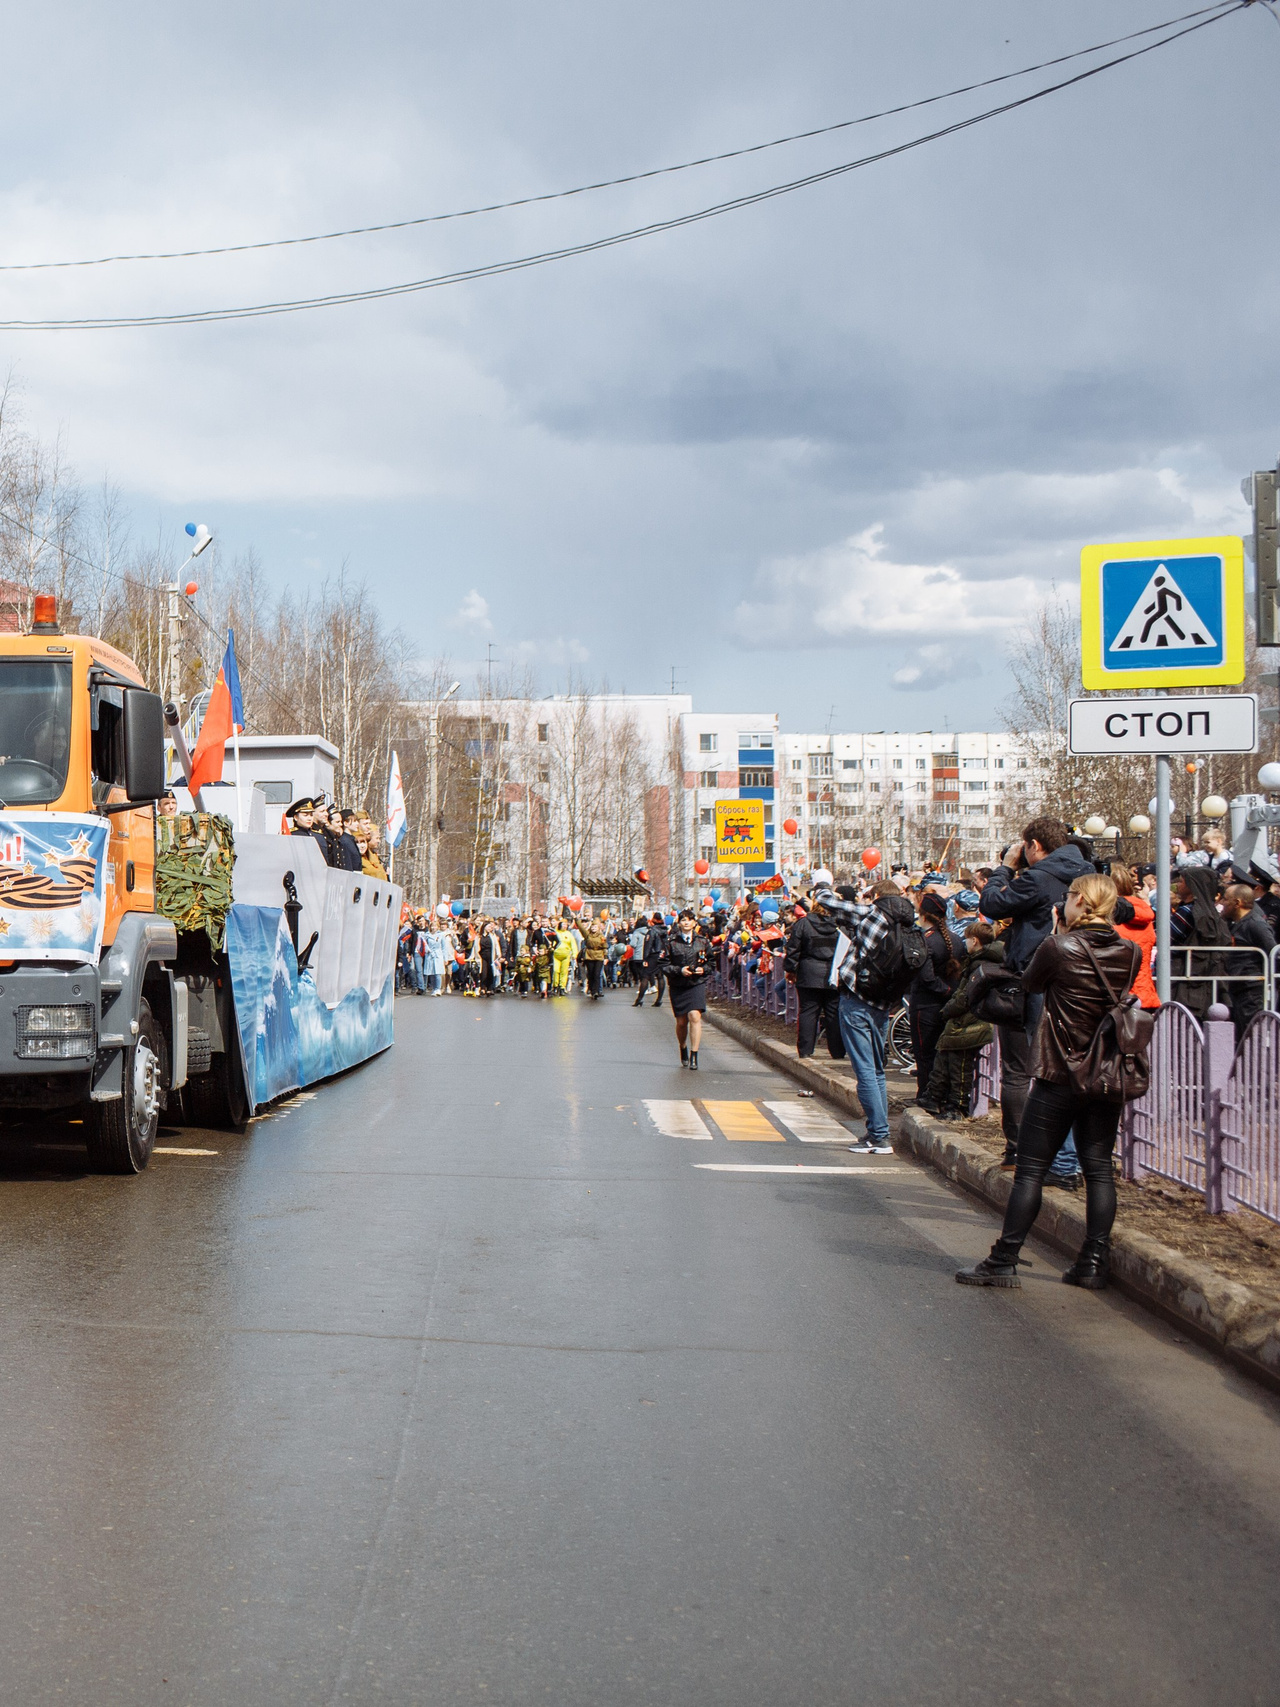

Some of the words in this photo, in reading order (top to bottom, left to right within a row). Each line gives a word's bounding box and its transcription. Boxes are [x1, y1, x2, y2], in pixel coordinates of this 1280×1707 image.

[1104, 711, 1210, 738] СТОП
[717, 805, 746, 815] Сбрось
[719, 846, 764, 856] ШКОЛА!
